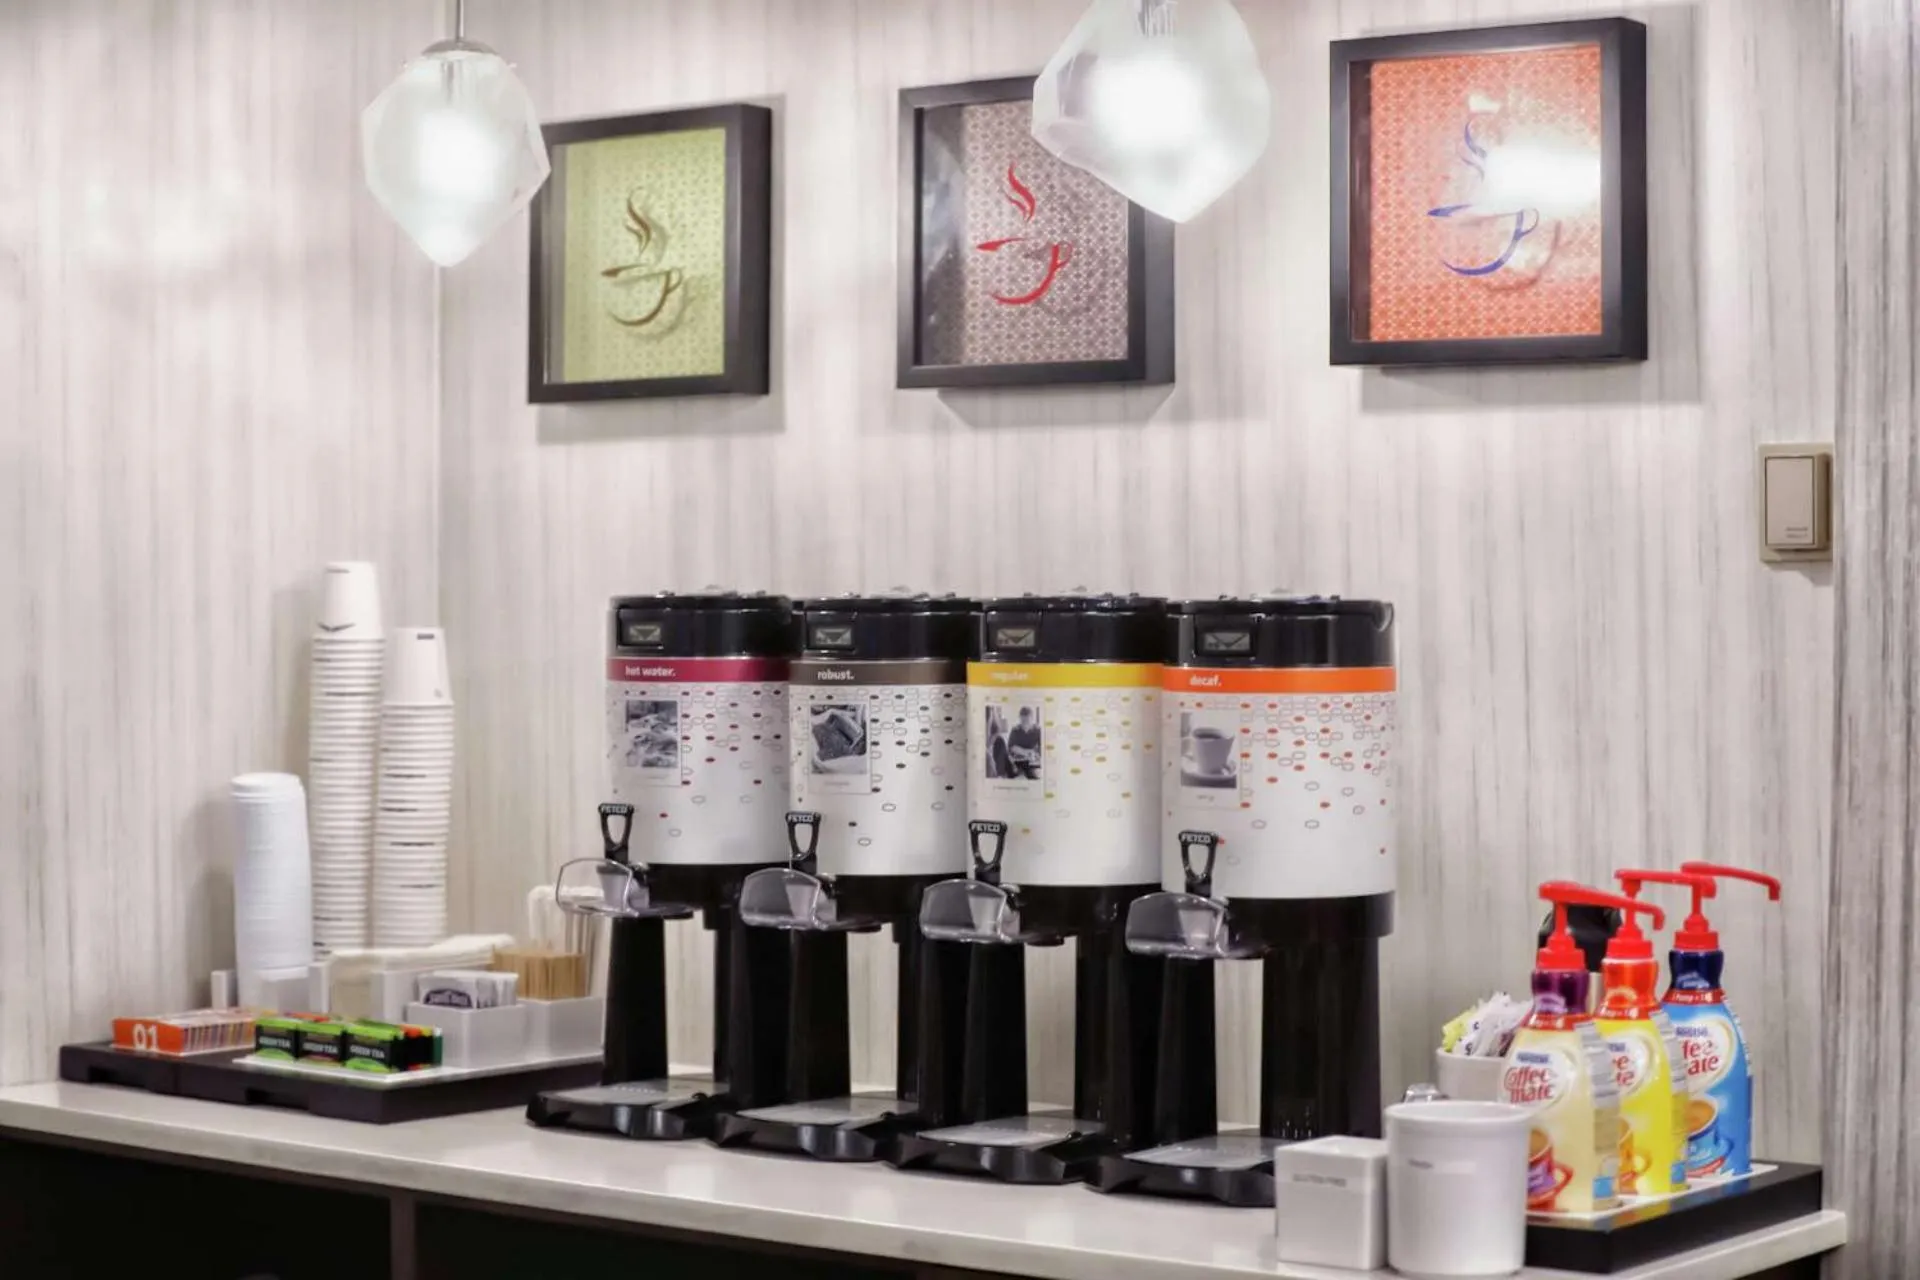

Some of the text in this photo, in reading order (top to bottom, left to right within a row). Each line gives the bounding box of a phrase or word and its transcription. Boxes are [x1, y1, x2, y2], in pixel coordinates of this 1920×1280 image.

[625, 665, 676, 677] hot water.
[817, 669, 854, 680] robust.
[1189, 674, 1222, 686] decaf.
[601, 805, 628, 814] FETCO
[787, 814, 814, 823] FETCO
[970, 822, 1001, 832] FETCO
[1181, 833, 1212, 844] FETCO
[132, 1023, 158, 1050] 01
[371, 1048, 385, 1059] TEA
[1687, 1055, 1719, 1076] ate
